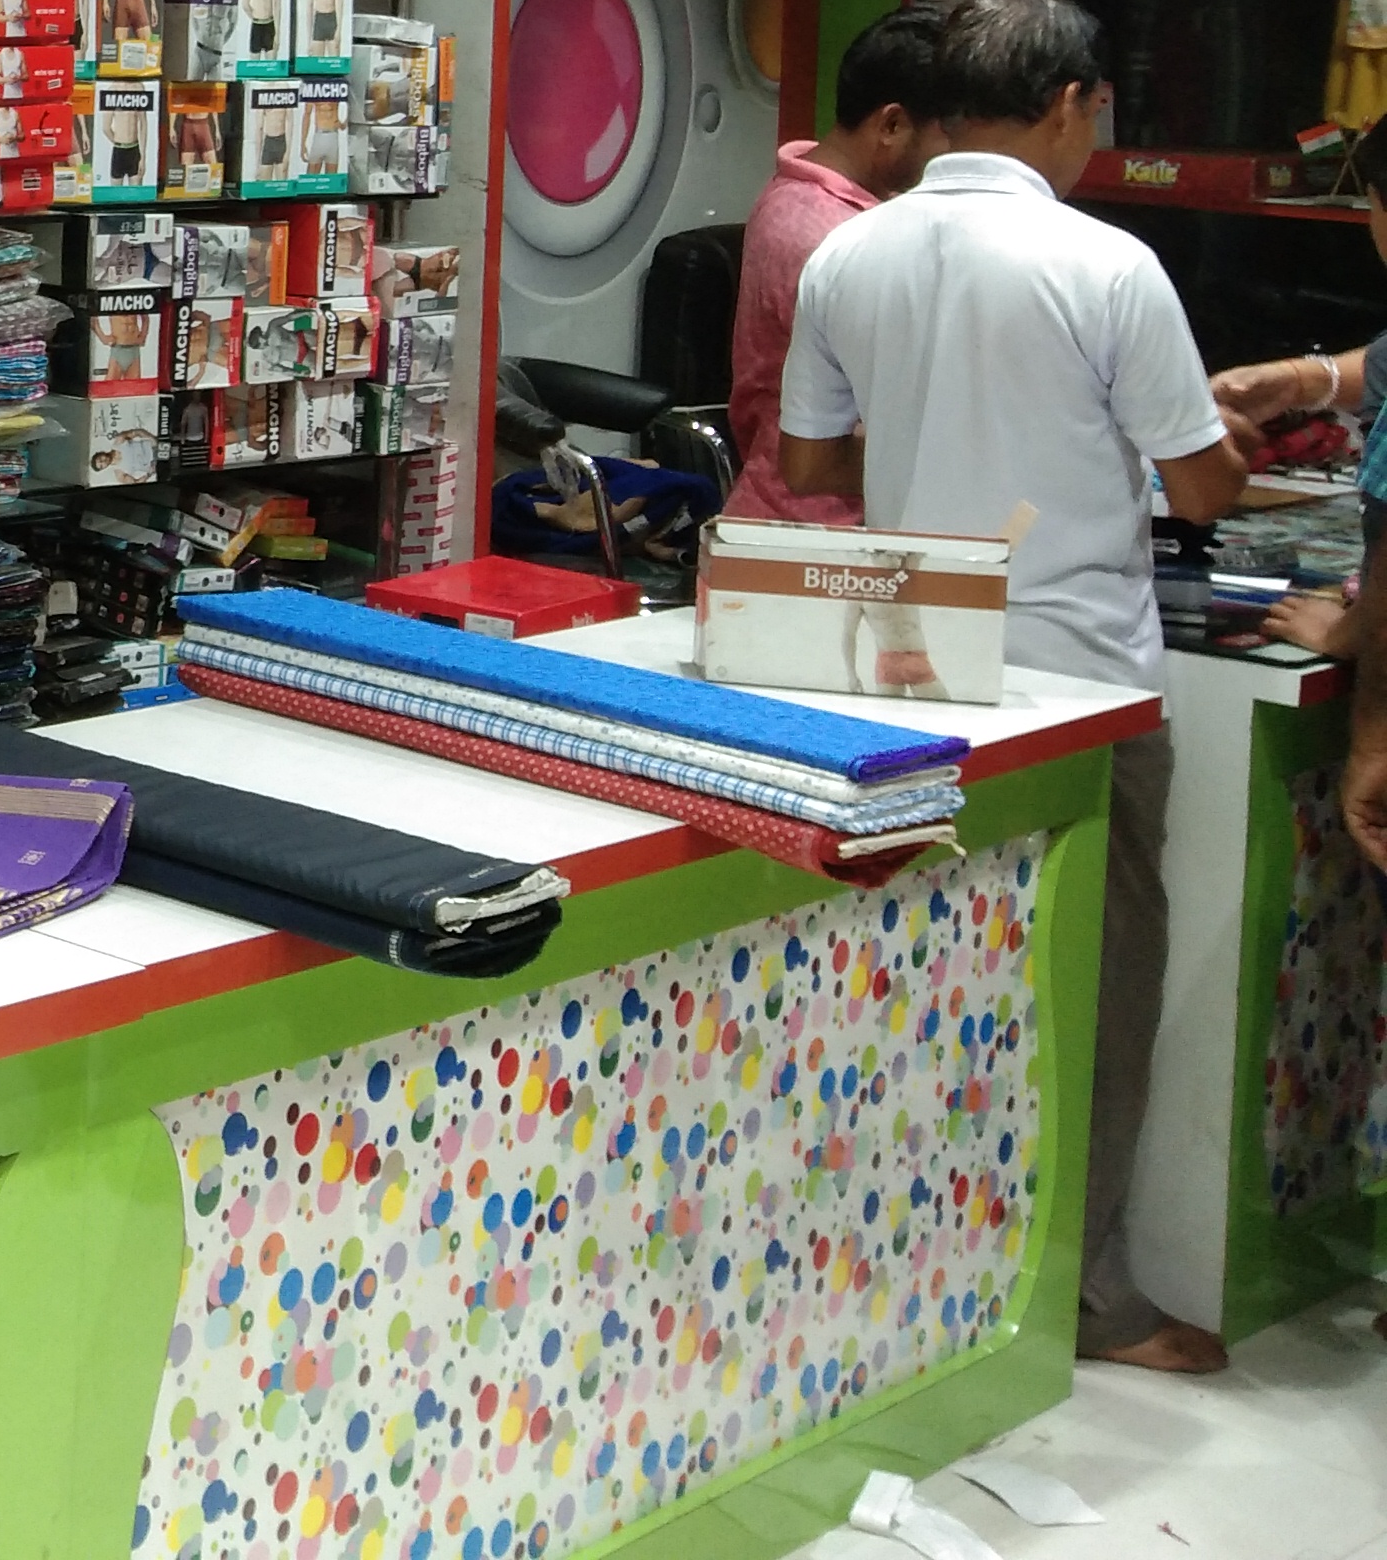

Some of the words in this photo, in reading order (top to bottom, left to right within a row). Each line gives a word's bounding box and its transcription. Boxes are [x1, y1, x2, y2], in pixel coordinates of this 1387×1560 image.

[105, 95, 148, 107] MACHO
[258, 93, 295, 105] MACHO
[325, 219, 336, 283] MACHO
[184, 240, 198, 297] Bigboss
[100, 294, 154, 312] MACHO
[175, 305, 189, 380] MACHO
[161, 405, 169, 435] BRIEF
[388, 395, 404, 452] Bigboss
[804, 566, 898, 598] Bigboss
